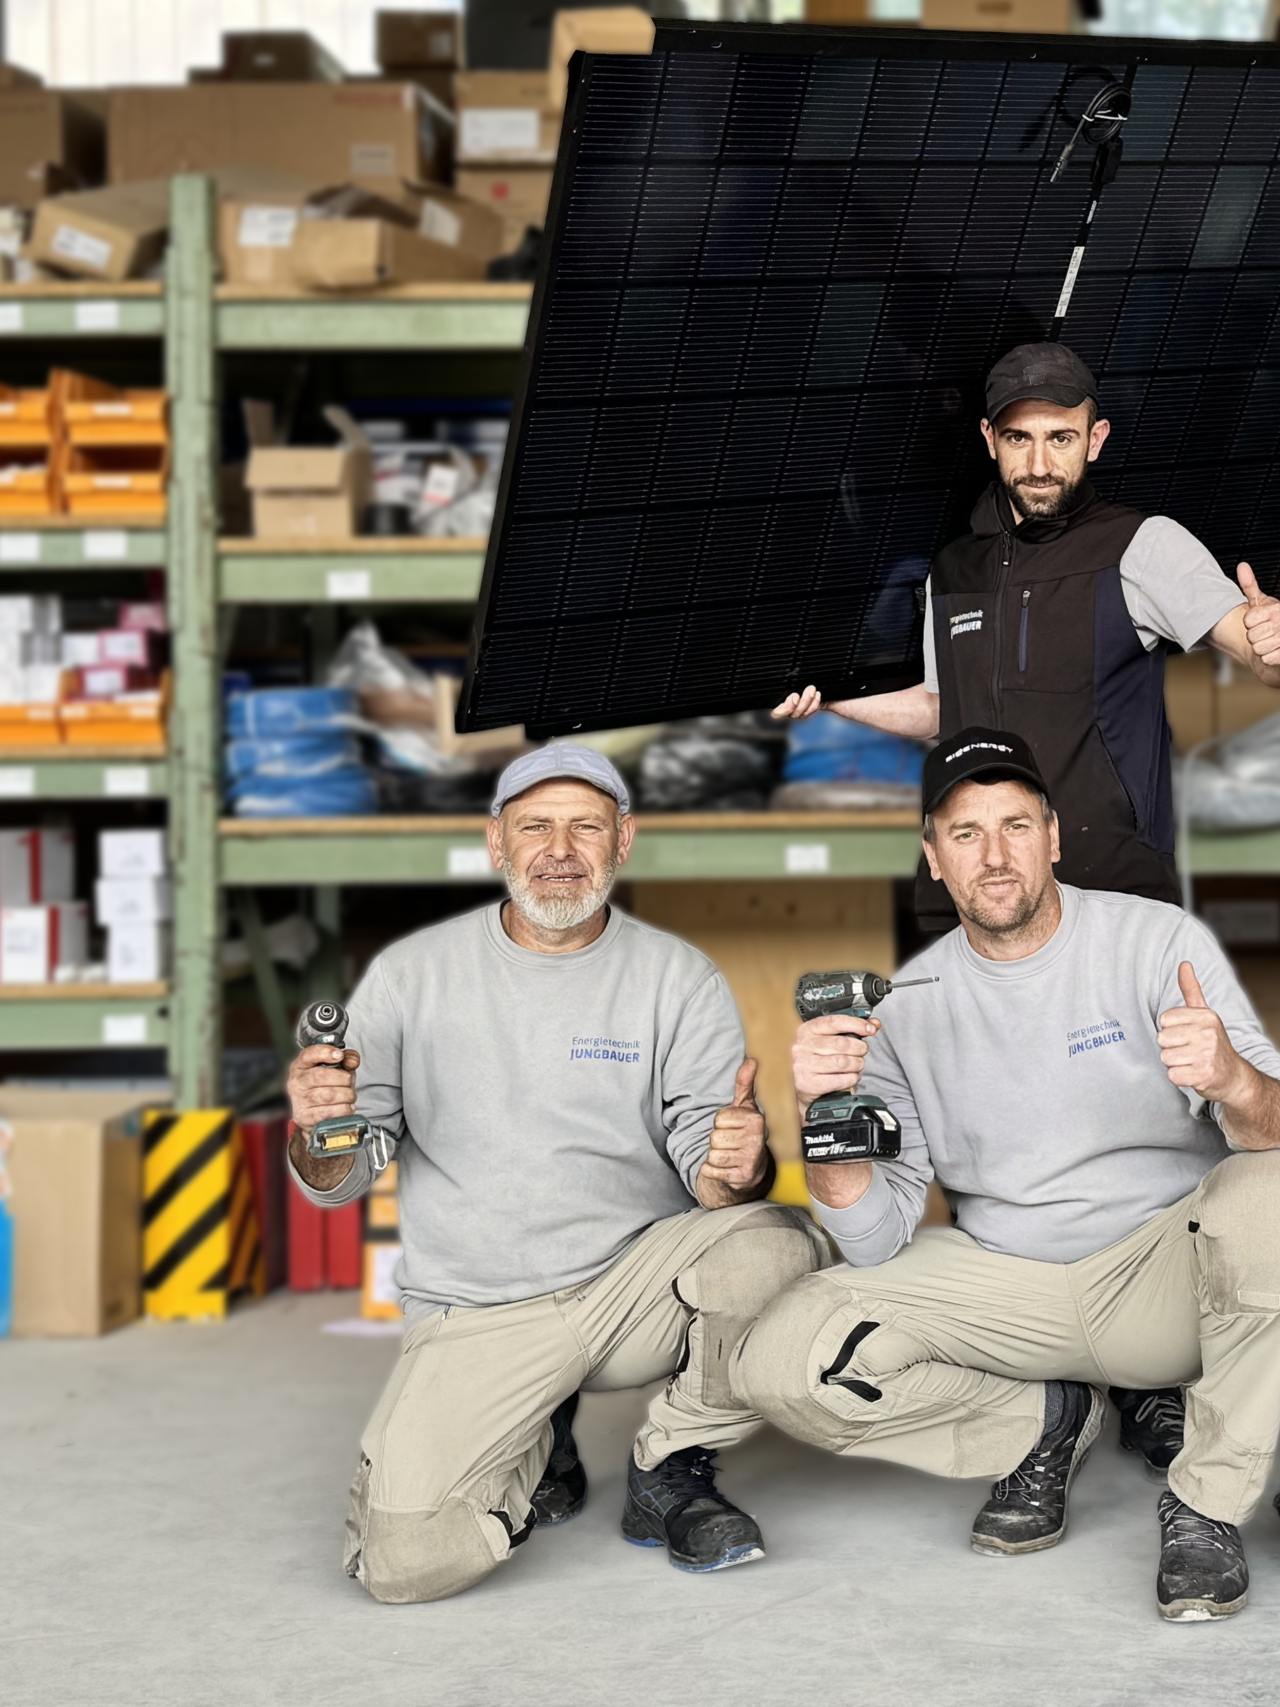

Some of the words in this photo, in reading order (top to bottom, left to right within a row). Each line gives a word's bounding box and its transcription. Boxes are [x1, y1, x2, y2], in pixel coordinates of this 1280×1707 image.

[1067, 1019, 1121, 1041] Energietechnik
[572, 1036, 640, 1049] Energietechnik
[1069, 1031, 1126, 1058] JUNGBAUER
[570, 1048, 640, 1063] JUNGBAUER
